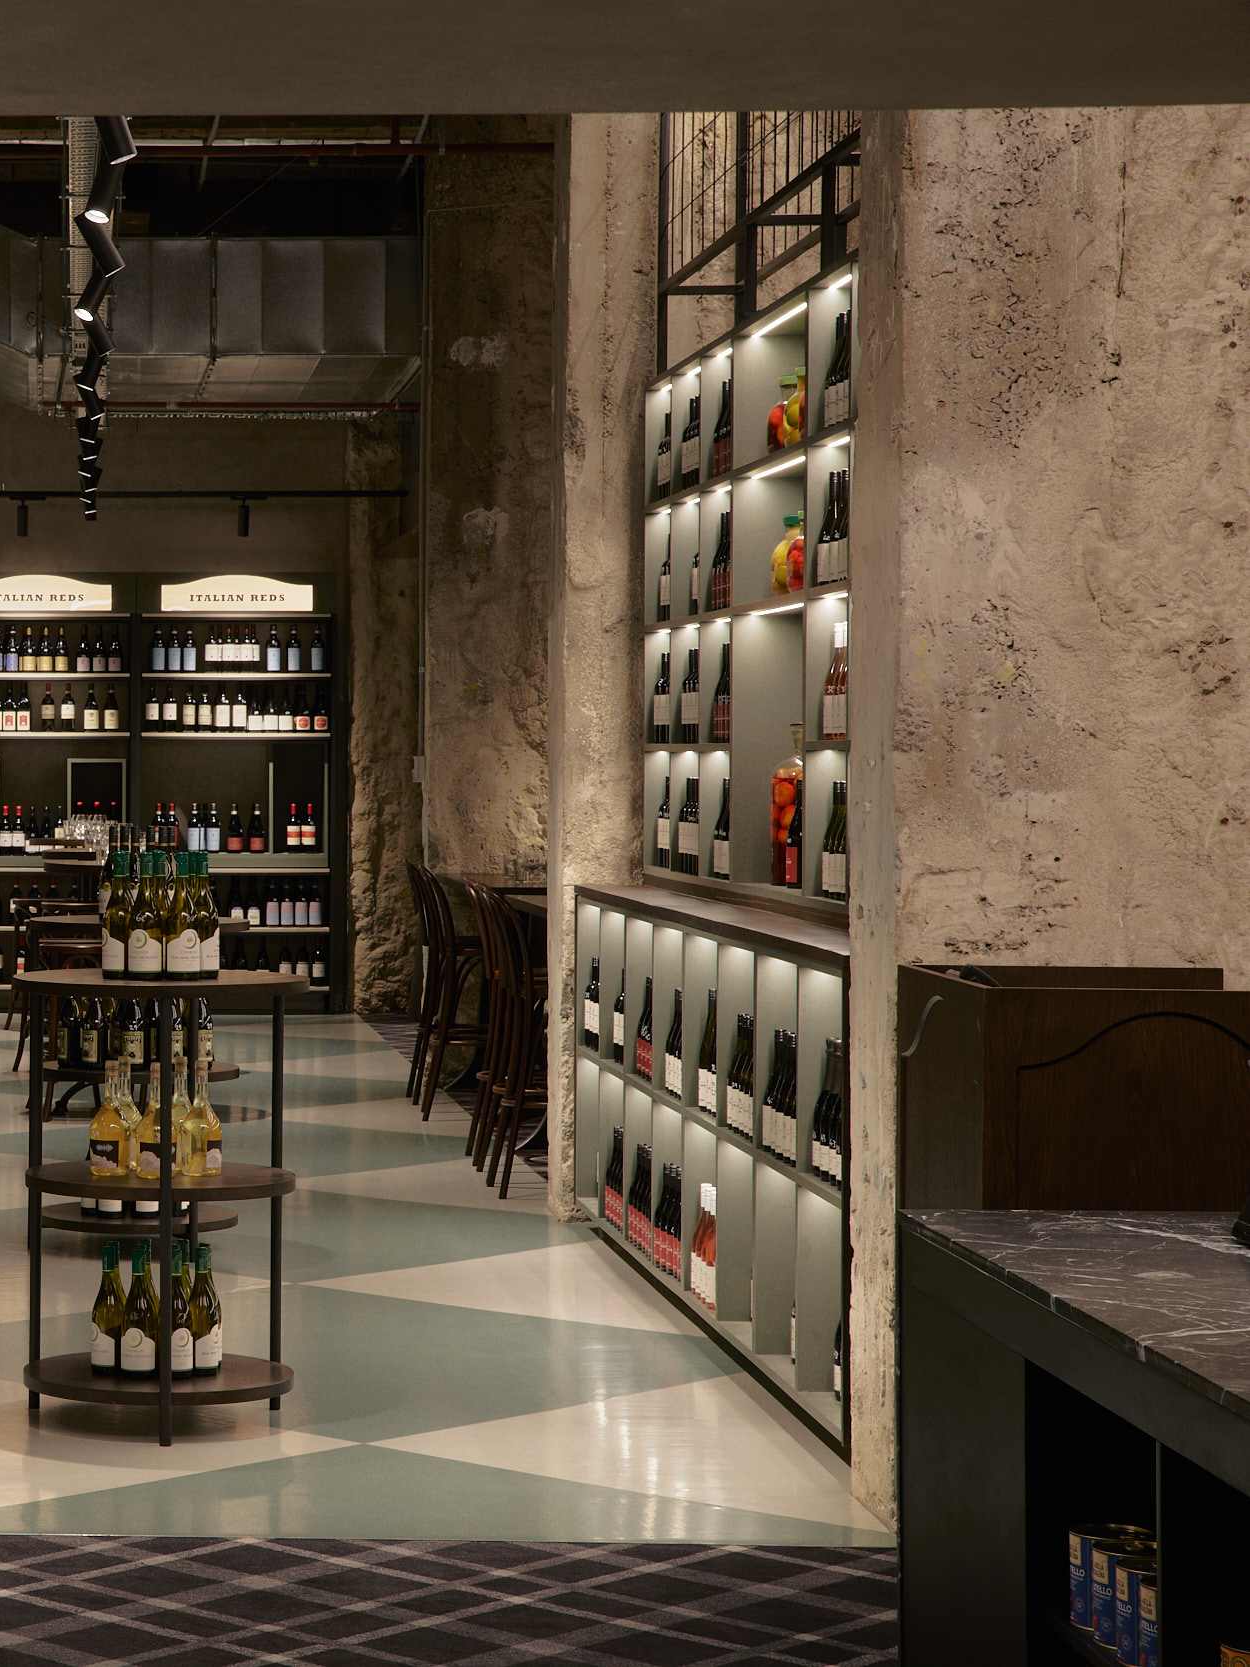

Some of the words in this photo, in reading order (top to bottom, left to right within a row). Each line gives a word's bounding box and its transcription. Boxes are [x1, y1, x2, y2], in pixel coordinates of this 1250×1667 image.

[49, 594, 84, 602] REDS
[190, 594, 244, 602] ITALIAN
[250, 594, 285, 602] REDS
